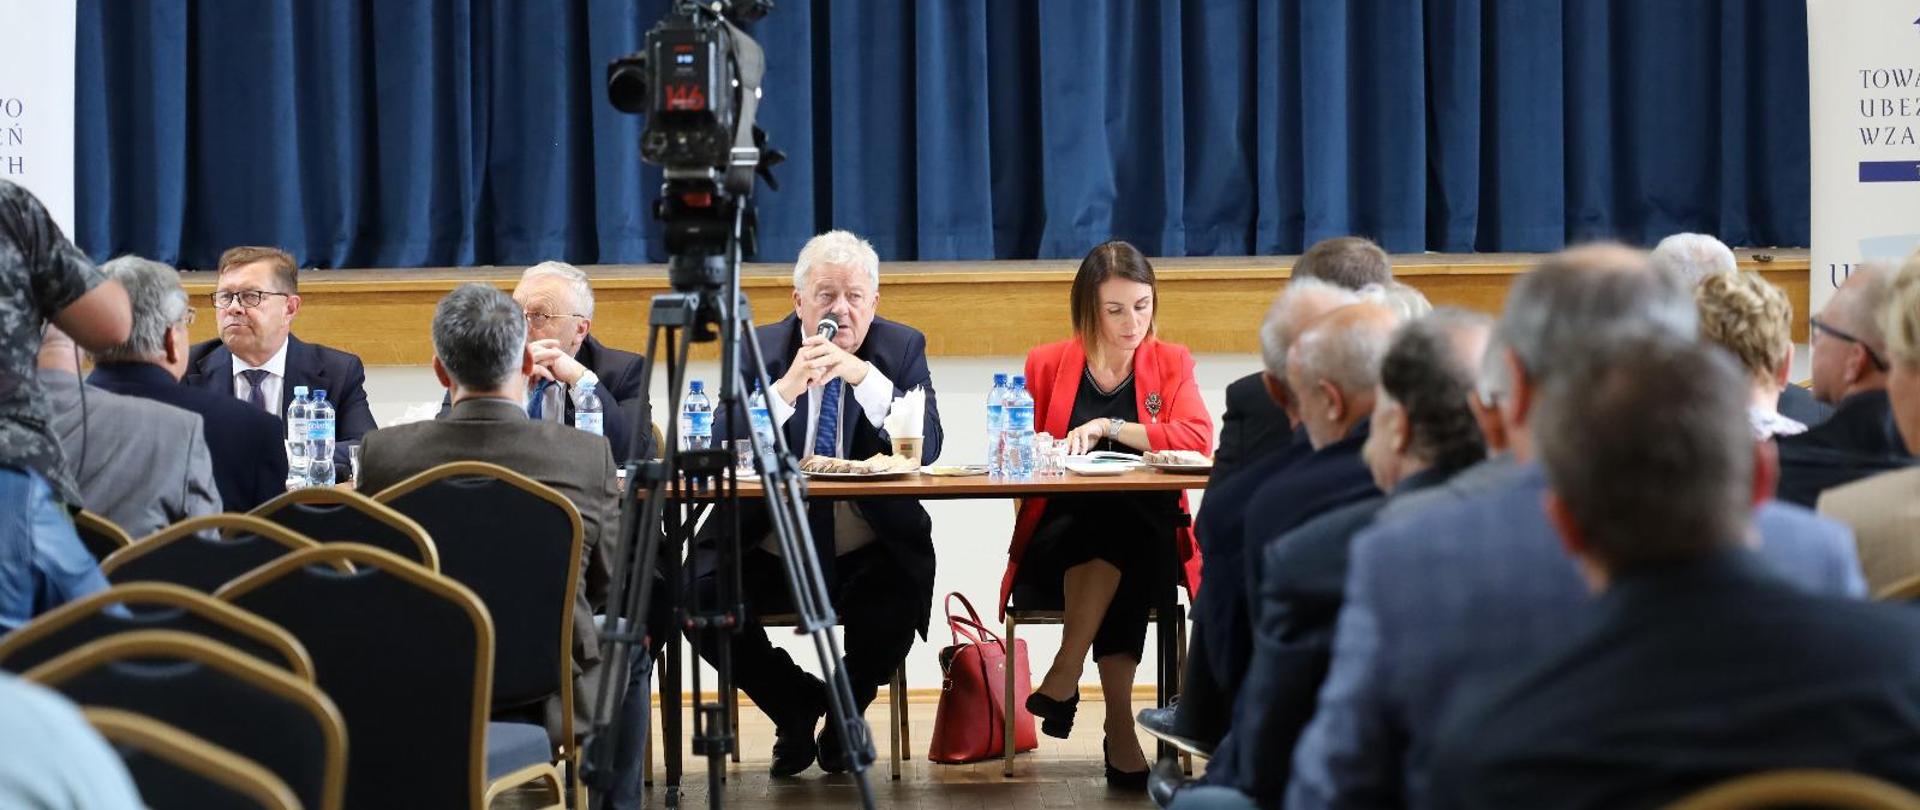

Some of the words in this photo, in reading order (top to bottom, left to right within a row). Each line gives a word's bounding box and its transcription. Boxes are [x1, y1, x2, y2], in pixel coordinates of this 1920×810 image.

[0, 98, 23, 118] O
[665, 84, 705, 112] 146
[0, 122, 23, 146] Ń
[0, 156, 24, 174] H
